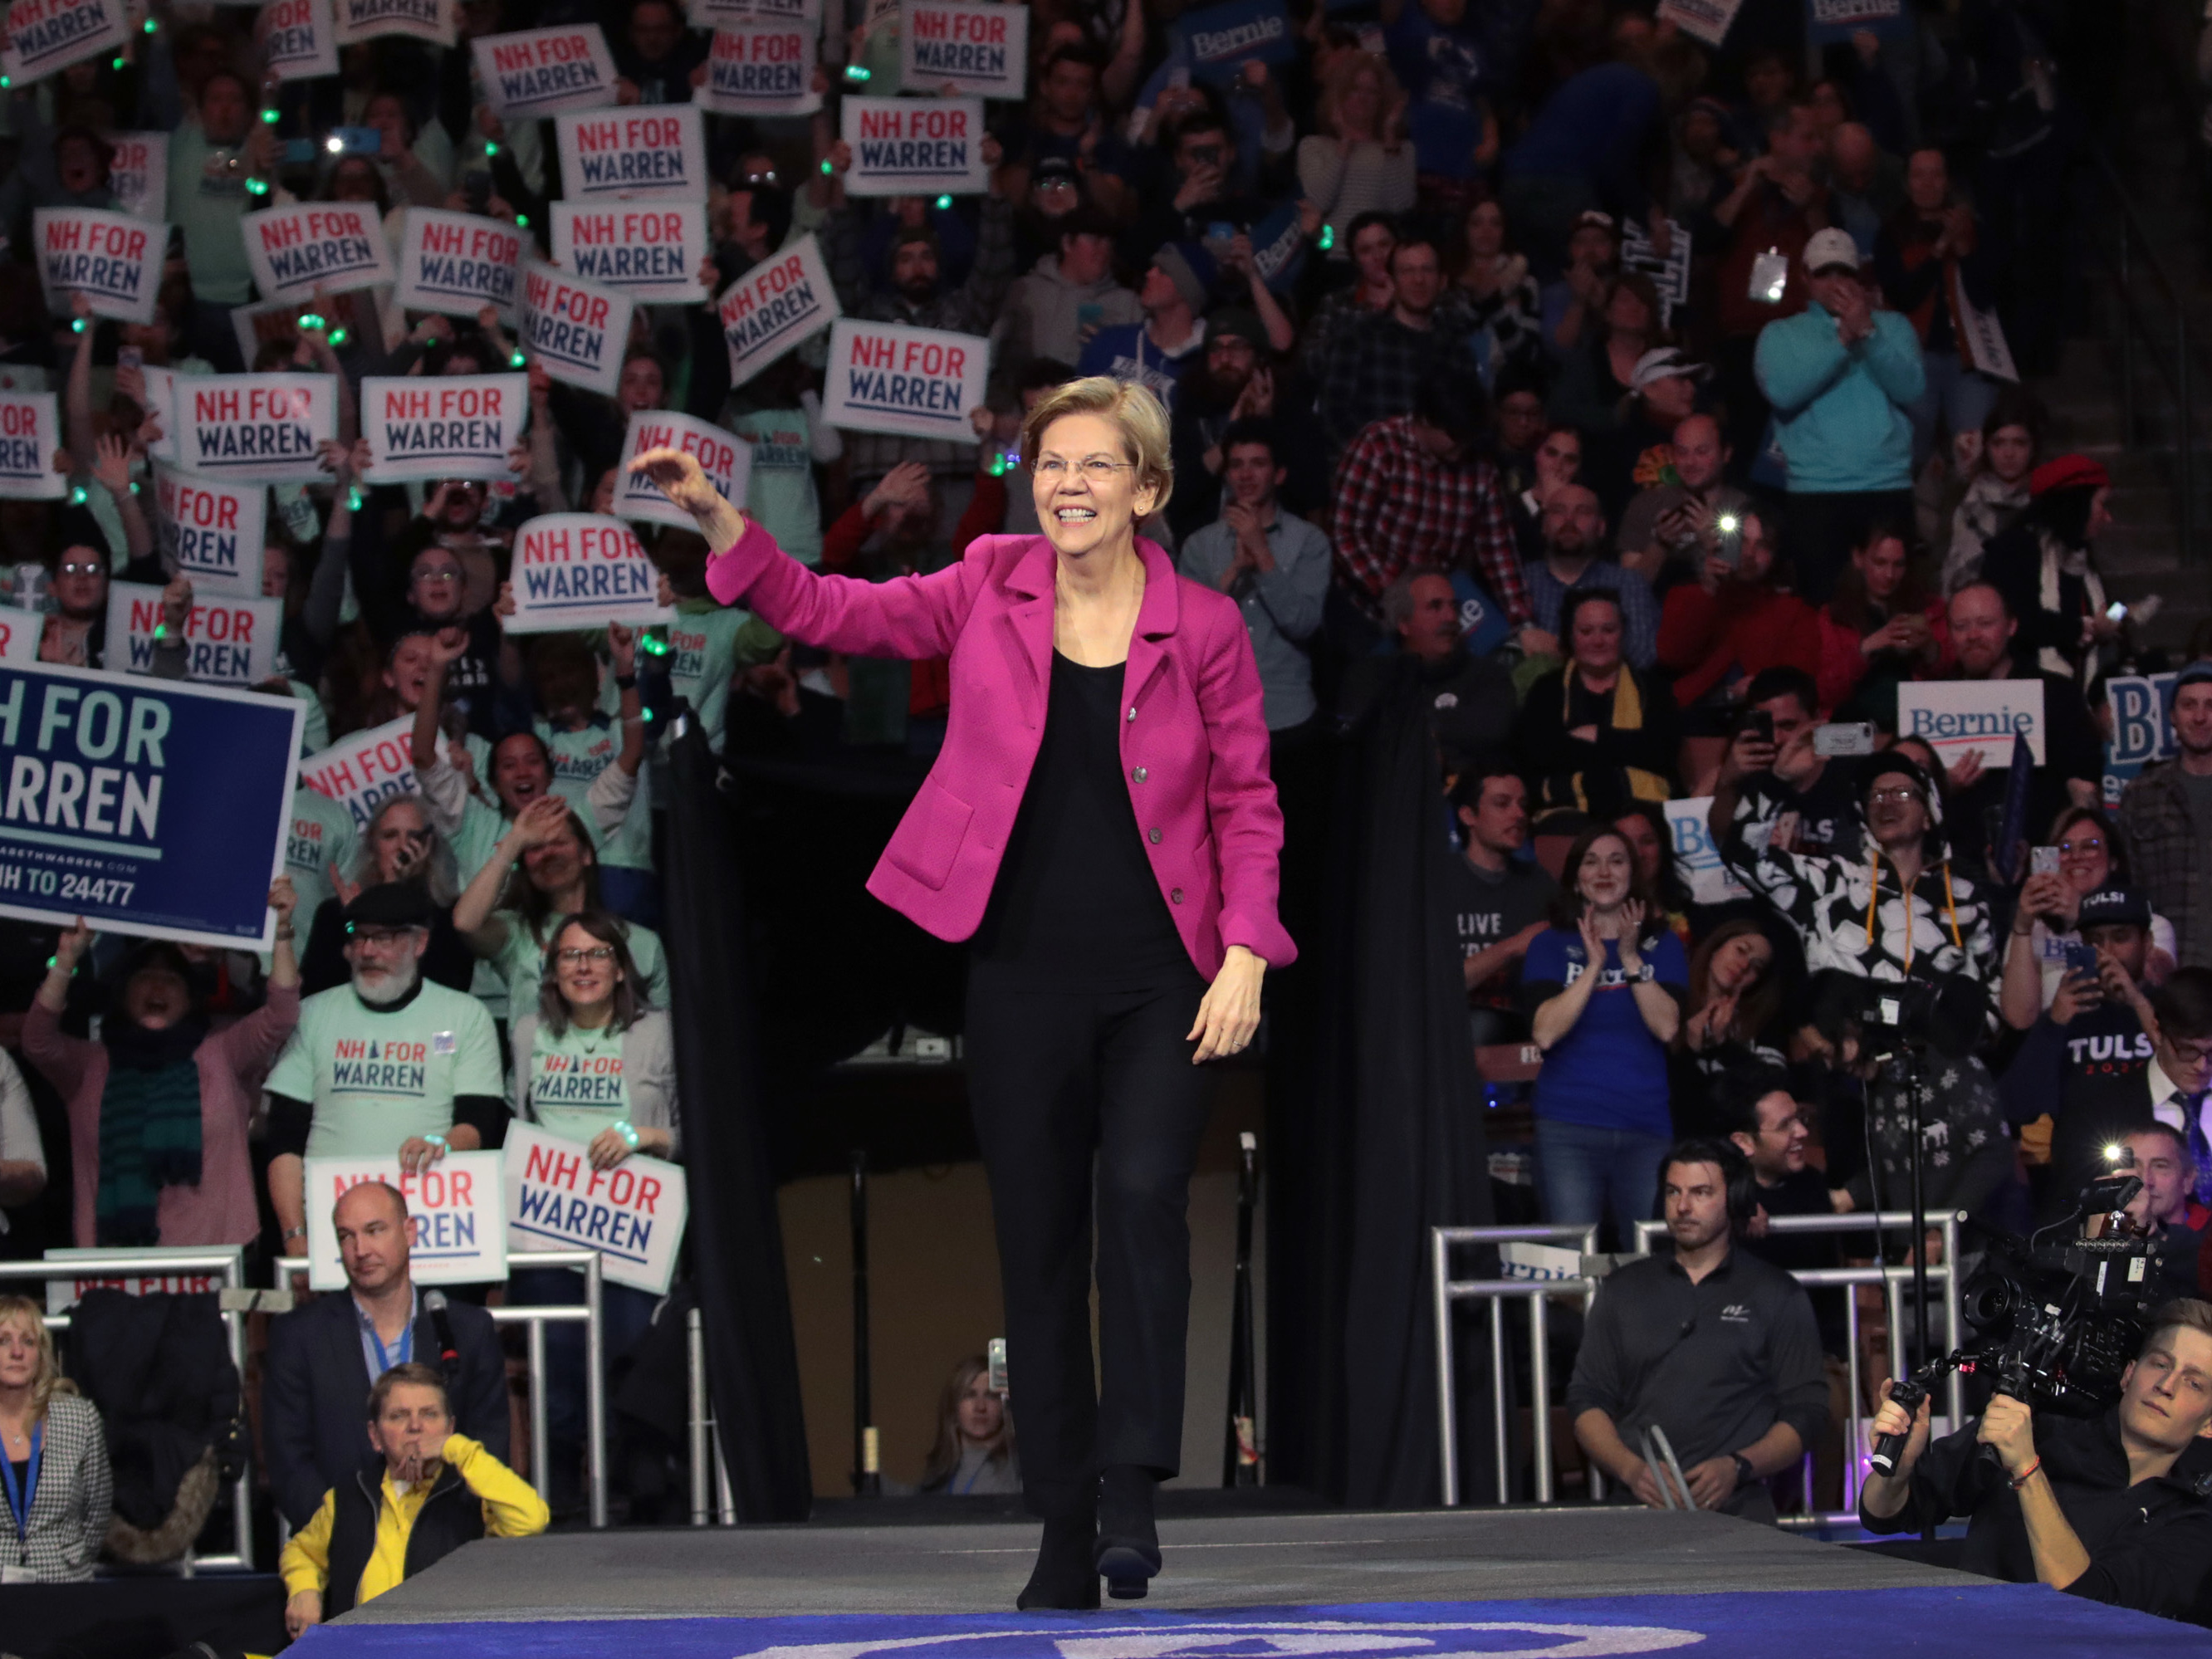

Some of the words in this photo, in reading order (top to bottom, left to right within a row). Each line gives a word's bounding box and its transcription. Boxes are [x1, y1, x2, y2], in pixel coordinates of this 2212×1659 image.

[14, 5, 105, 55] WARREN
[272, 0, 312, 28] OR
[914, 9, 946, 39] NH
[953, 13, 1006, 43] FOR
[269, 27, 315, 53] REN
[493, 44, 533, 71] NH
[541, 35, 590, 64] FOR
[712, 32, 744, 61] NH
[752, 33, 801, 62] FOR
[915, 40, 1006, 71] WARREN
[1192, 14, 1284, 61] Bernie
[499, 61, 599, 100] WARREN
[712, 64, 801, 91] WARREN
[577, 123, 618, 151] NH
[628, 118, 683, 147] FOR
[861, 110, 901, 139] NH
[909, 110, 967, 138] FOR
[581, 151, 683, 184] WARREN
[860, 141, 967, 168] WARREN
[46, 221, 80, 249] NH
[88, 223, 146, 261] FOR
[261, 218, 303, 251] NH
[309, 213, 365, 240] FOR
[422, 222, 463, 254] NH
[472, 229, 521, 267] FOR
[572, 213, 614, 245] NH
[624, 212, 683, 243] FOR
[48, 254, 142, 293] WARREN
[268, 237, 373, 281] WARREN
[419, 254, 516, 298] WARREN
[574, 247, 685, 277] WARREN
[526, 270, 551, 311] NH
[554, 285, 609, 330] FOR
[720, 291, 755, 328] NH
[756, 254, 805, 304] FOR
[727, 281, 816, 352] WARREN
[523, 309, 604, 362] WARREN
[851, 335, 896, 369] NH
[903, 340, 966, 379] FOR
[195, 390, 238, 423] NH
[251, 388, 312, 420] FOR
[385, 390, 429, 418] NH
[440, 388, 502, 418] FOR
[849, 368, 962, 412] WARREN
[197, 423, 312, 458] WARREN
[386, 419, 502, 452] WARREN
[0, 440, 39, 469] REN
[680, 431, 734, 478] FOR
[179, 487, 238, 531] FOR
[176, 526, 237, 566] REN
[523, 531, 570, 565] NH
[581, 527, 646, 559] FOR
[524, 562, 649, 600] WARREN
[187, 607, 254, 643] FOR
[129, 635, 252, 679] WREN
[0, 679, 26, 748] H
[37, 683, 172, 768] FOR
[1910, 706, 2033, 737] Bernie
[0, 754, 163, 841] RREN
[303, 760, 357, 799] NH
[294, 819, 322, 842] OR
[286, 834, 322, 864] REN
[27, 867, 58, 897] TO
[60, 873, 136, 908] 24477
[2082, 890, 2125, 908] TULSI
[1456, 913, 1502, 936] LIVE
[335, 1039, 365, 1060] NH
[384, 1041, 426, 1063] FOR
[544, 1054, 569, 1073] NH
[582, 1057, 623, 1074] FOR
[2067, 1033, 2155, 1064] TULS
[334, 1062, 425, 1089] WARREN
[536, 1075, 622, 1100] WARREN
[525, 1144, 583, 1190] NH
[587, 1167, 661, 1215] FOR
[413, 1211, 476, 1250] REN
[520, 1184, 653, 1252] WARREN
